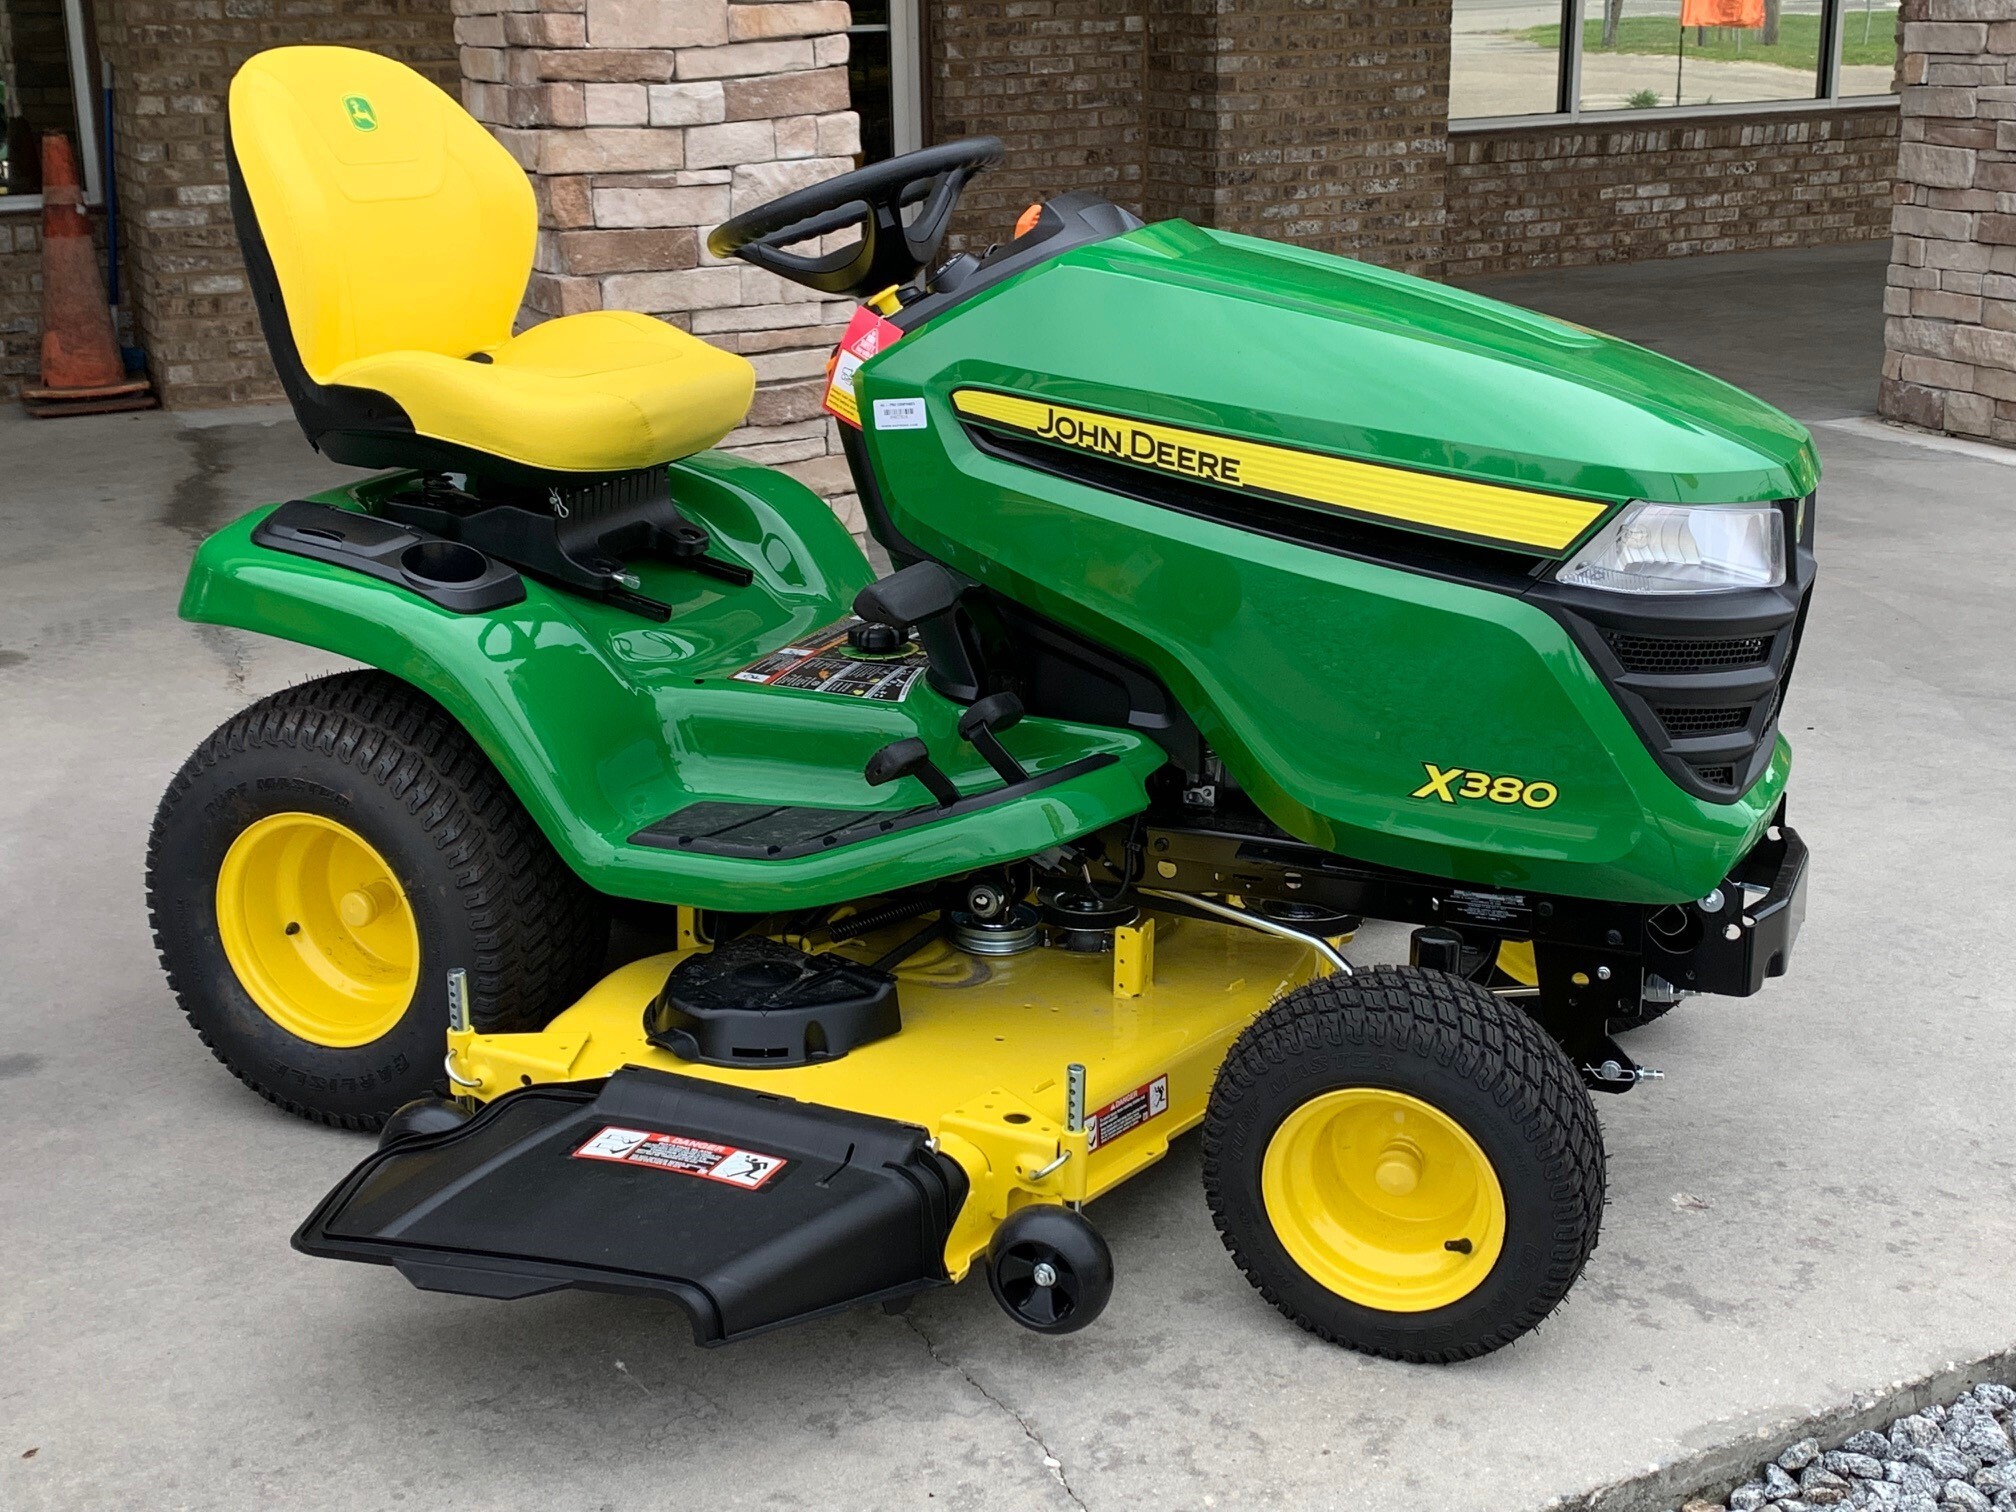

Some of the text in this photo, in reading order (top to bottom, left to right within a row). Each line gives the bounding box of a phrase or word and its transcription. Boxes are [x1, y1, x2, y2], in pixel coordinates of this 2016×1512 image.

[1037, 408, 1242, 484] JOHN DEERE
[256, 776, 353, 809] MASTER
[1408, 762, 1559, 809] X380
[264, 1051, 410, 1094] CARLISLE
[1115, 1090, 1138, 1107] DANGER
[1230, 1051, 1397, 1161] TURF MASTER
[671, 1137, 726, 1152] DANGER
[1375, 1242, 1543, 1346] CARLISLE
